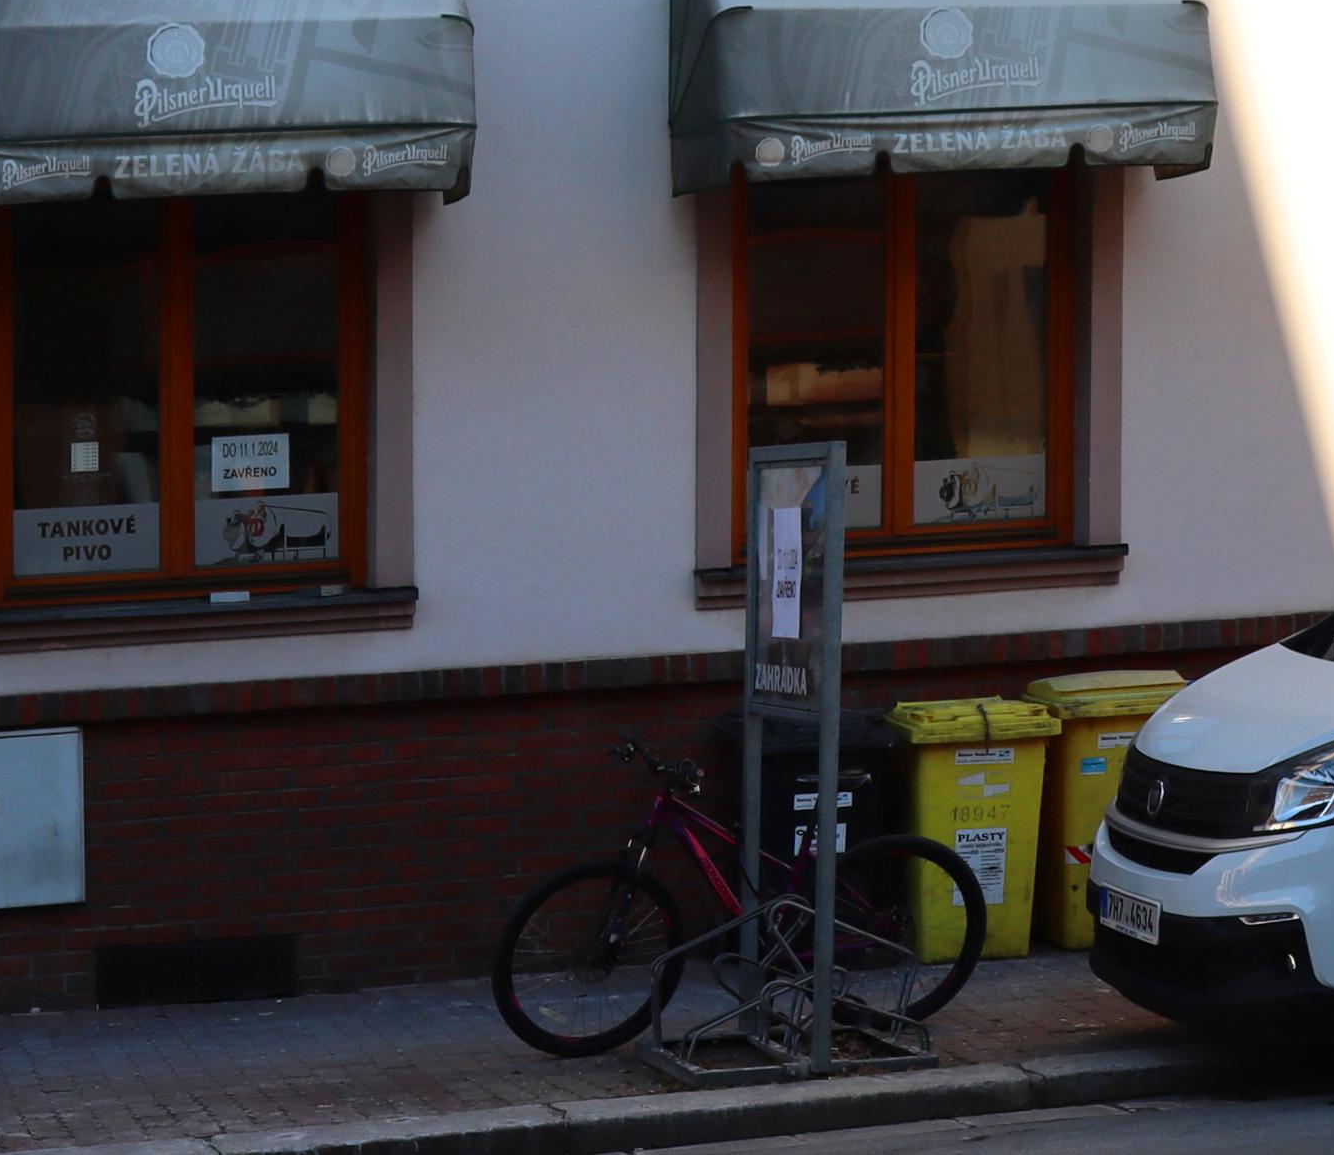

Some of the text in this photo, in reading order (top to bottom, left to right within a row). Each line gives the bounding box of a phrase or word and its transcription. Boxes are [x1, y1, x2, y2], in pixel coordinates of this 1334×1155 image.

[910, 57, 1041, 106] Pilsner Urquell
[133, 75, 279, 127] Pilsner Urquell
[790, 134, 832, 165] Pilsner
[892, 122, 1068, 154] ZELENÁ ŽÁBA
[1119, 121, 1196, 148] Pilsner Urquell
[1, 155, 91, 190] Pilsner Urquell
[114, 146, 306, 179] ZELENÁ ŽÁBA
[361, 144, 449, 177] Pilsner Urquell
[222, 442, 237, 458] DO
[223, 465, 277, 479] ZAVŘENO
[37, 515, 136, 538] TANKOVÉ
[62, 545, 112, 562] PIVO
[755, 661, 807, 696] ZAHRÁDKA
[951, 805, 1012, 822] 18947
[958, 831, 1005, 842] PLASTY
[1130, 902, 1154, 933] 4634
